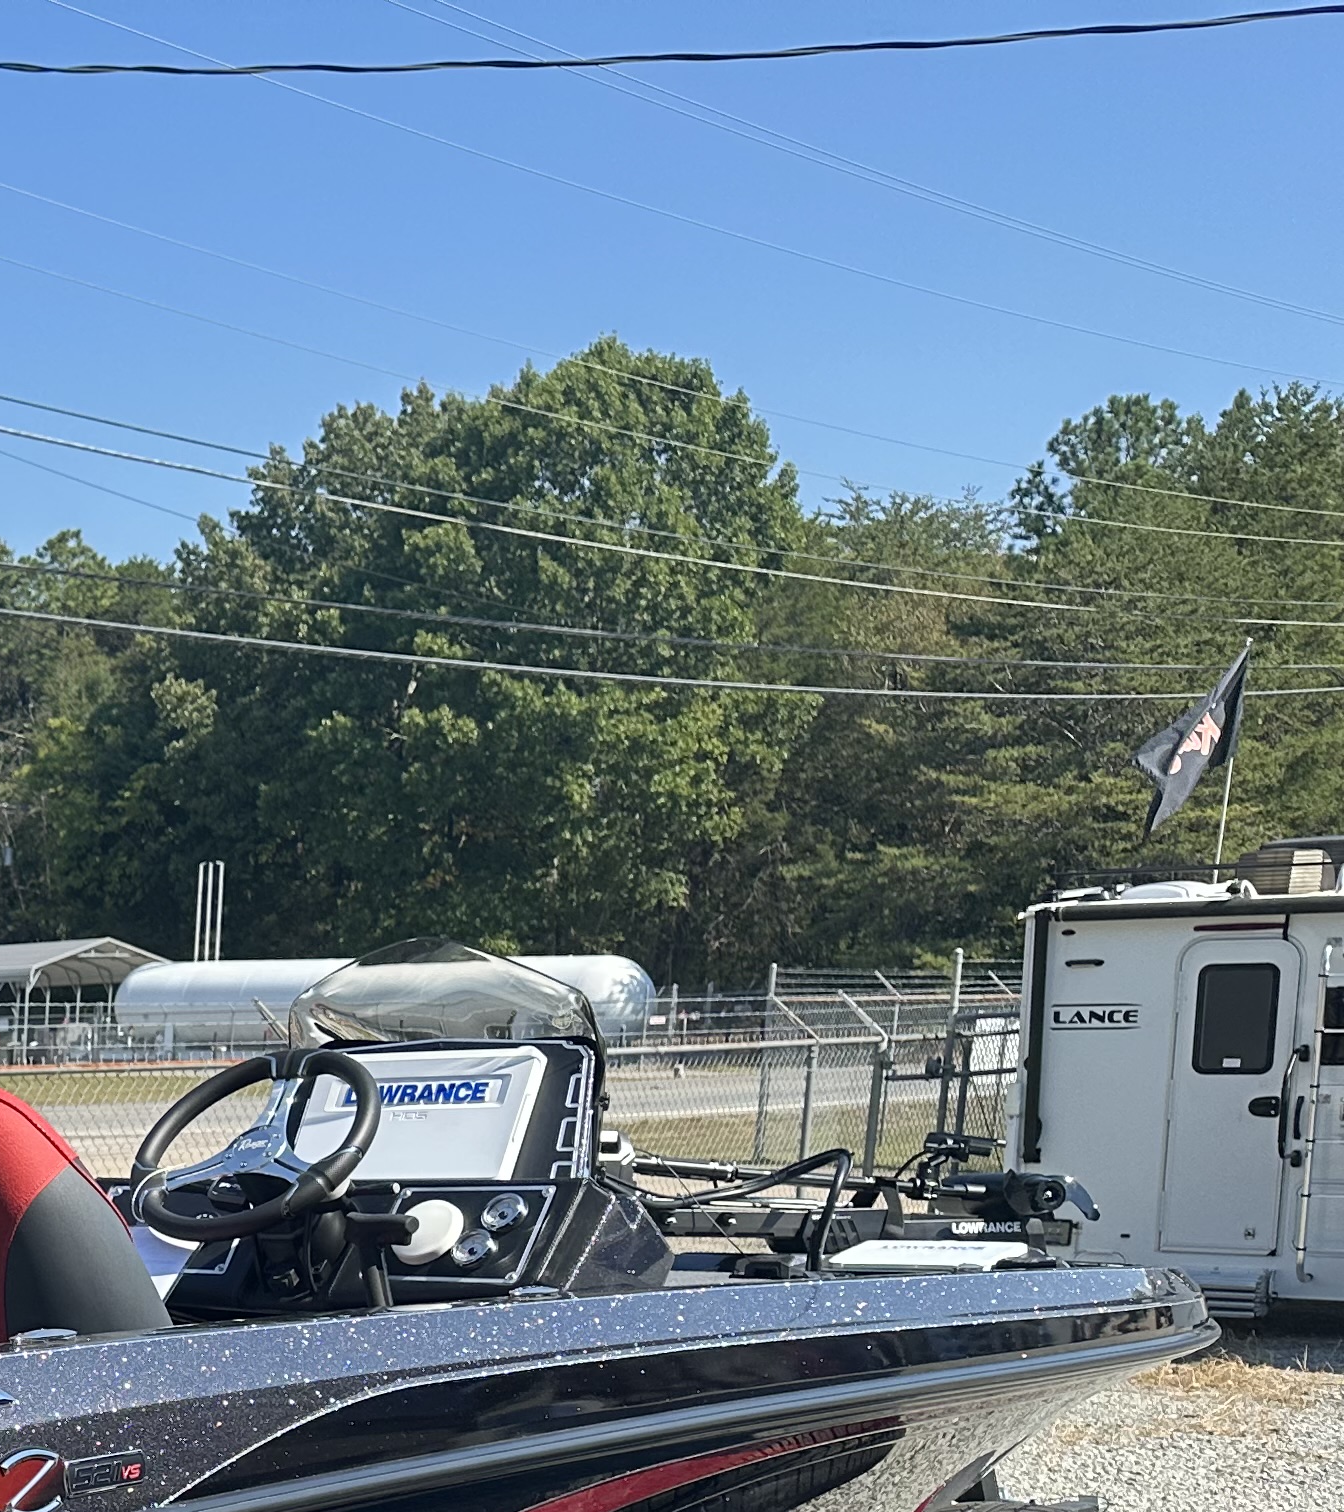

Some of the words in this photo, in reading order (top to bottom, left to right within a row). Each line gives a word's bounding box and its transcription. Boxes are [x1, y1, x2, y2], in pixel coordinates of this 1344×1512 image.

[1053, 1009, 1139, 1024] LANCE
[344, 1081, 490, 1105] LWRANCE
[951, 1221, 1022, 1235] LOWRANCE
